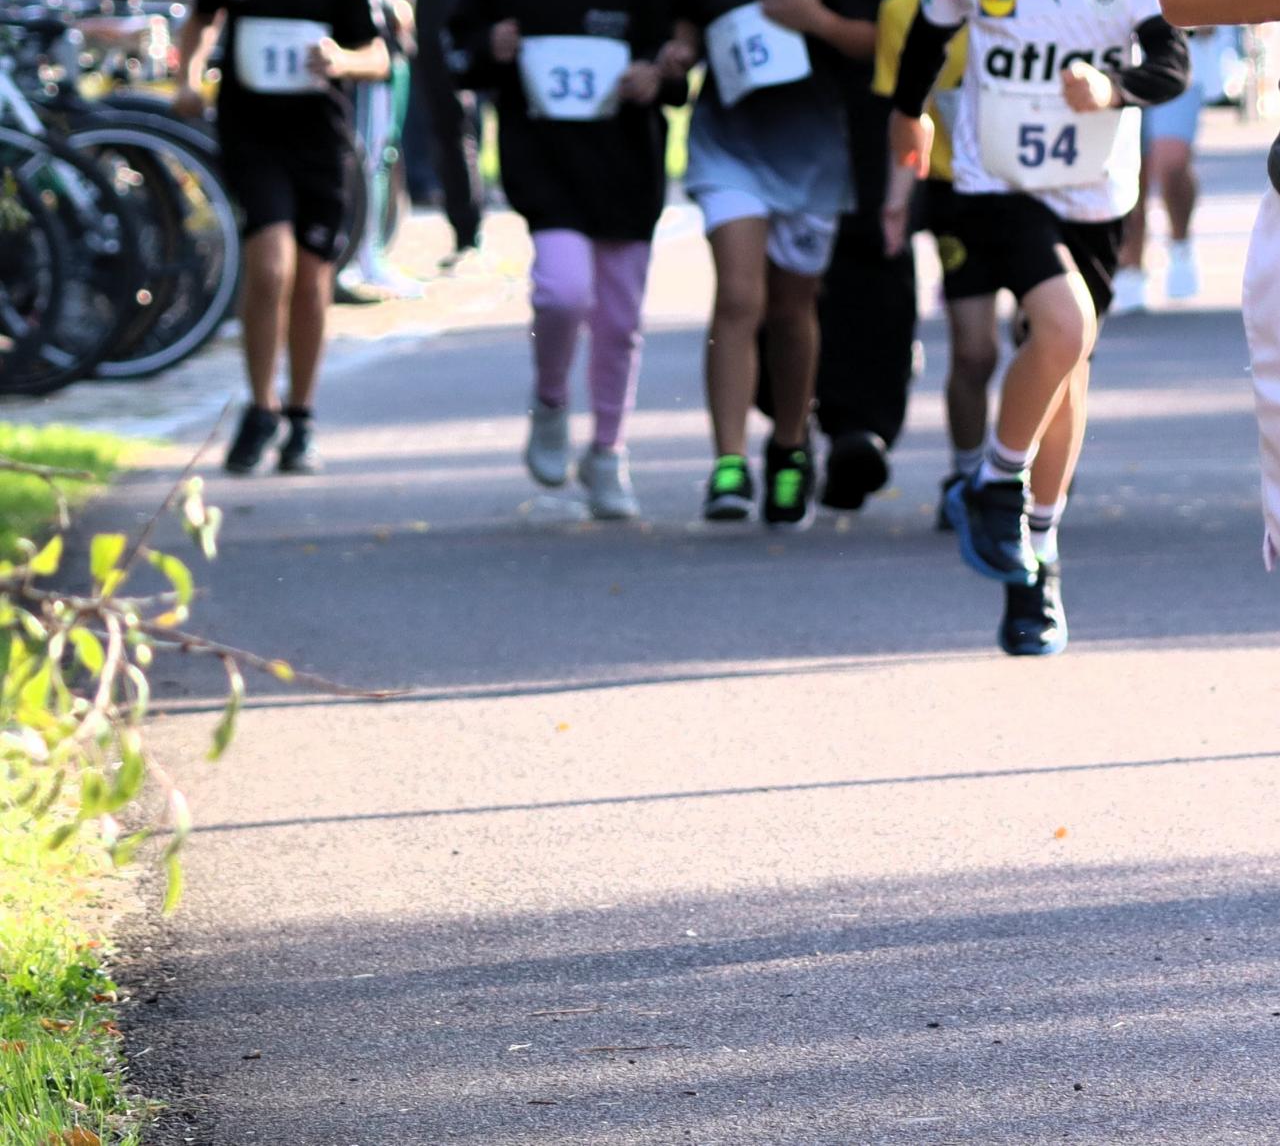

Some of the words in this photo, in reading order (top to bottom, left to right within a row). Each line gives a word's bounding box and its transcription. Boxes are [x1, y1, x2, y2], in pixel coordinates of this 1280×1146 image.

[729, 34, 770, 75] 15
[548, 65, 595, 101] 33
[1017, 123, 1079, 167] 54
